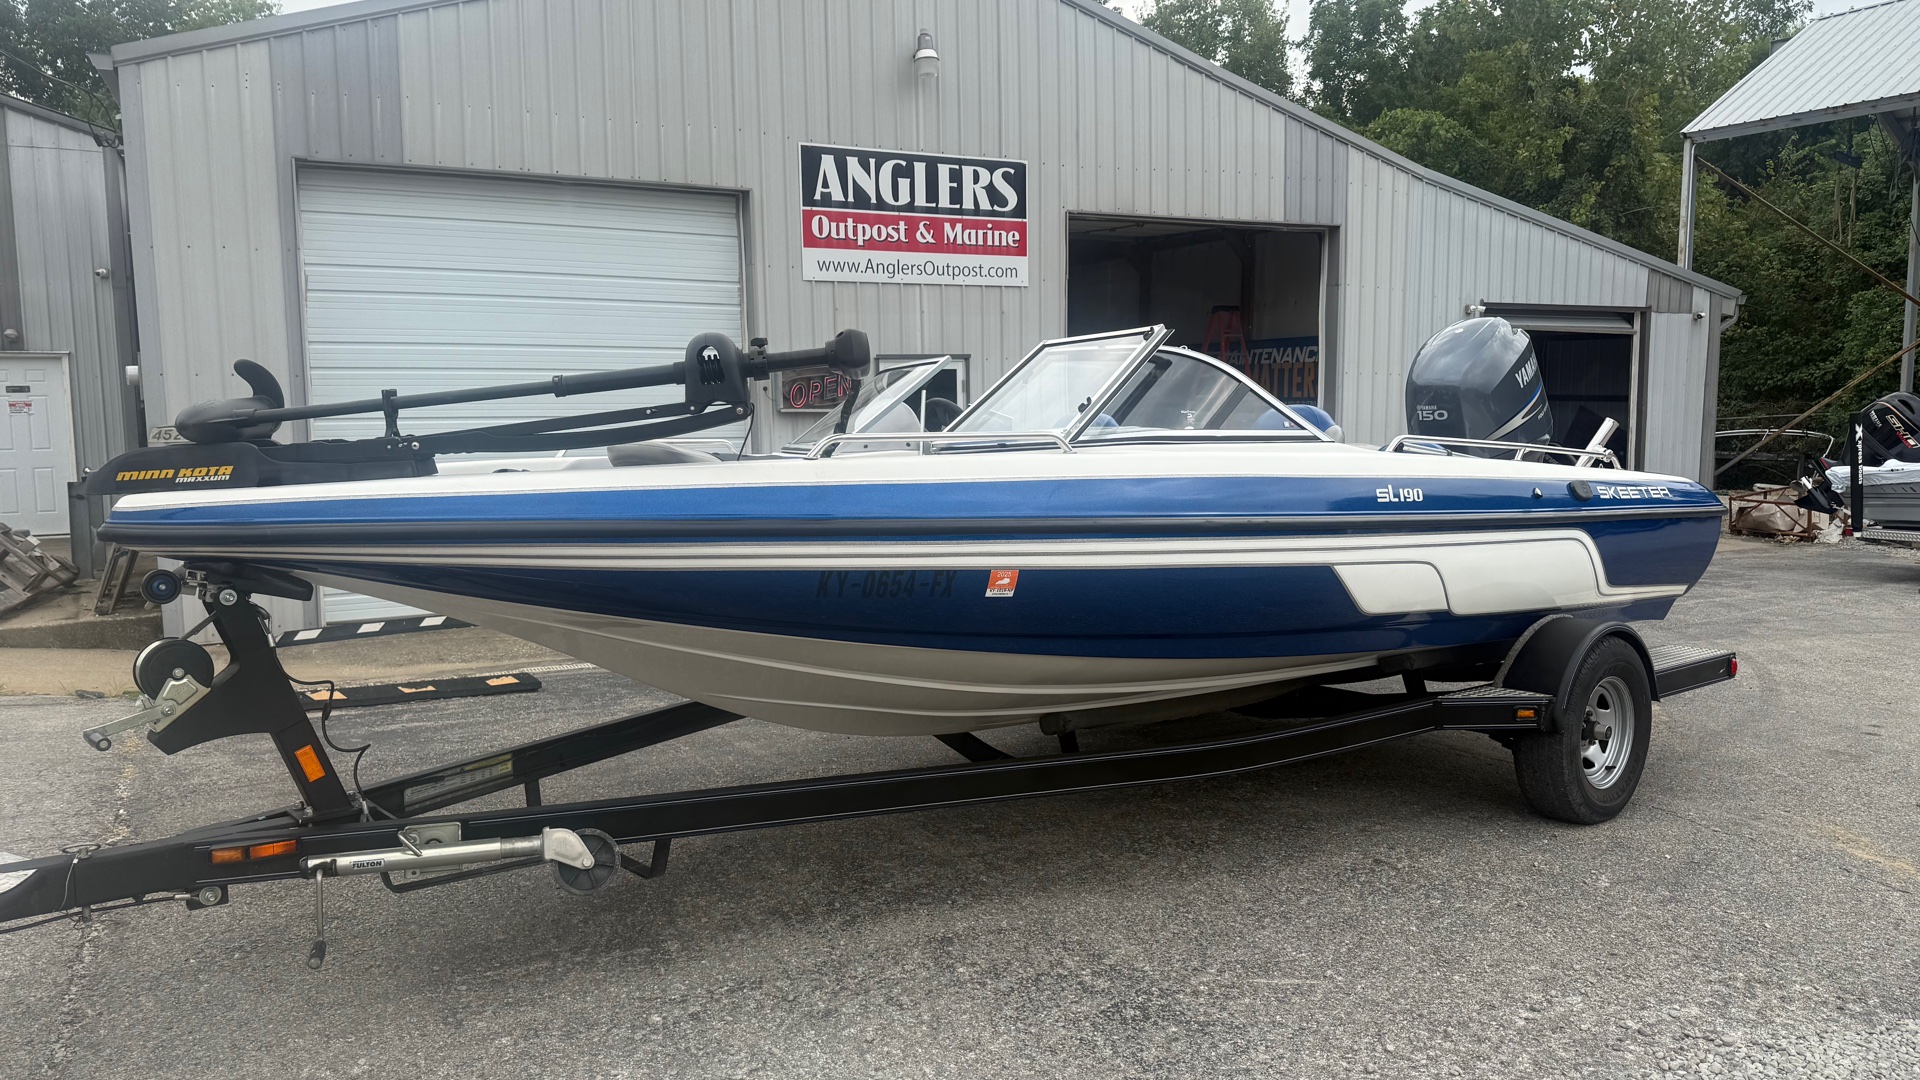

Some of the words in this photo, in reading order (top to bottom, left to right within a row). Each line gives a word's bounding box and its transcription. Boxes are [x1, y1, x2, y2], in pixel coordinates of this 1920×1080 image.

[813, 153, 1018, 212] ANGLERS
[811, 214, 908, 247] Outpost
[916, 221, 936, 244] &
[944, 222, 1020, 248] Marine
[816, 257, 1018, 279] www.AnglersOutpost.com
[1226, 346, 1319, 366] AINTENANC
[1250, 362, 1317, 398] ATTER
[790, 374, 852, 408] OPEN
[1416, 410, 1449, 421] 150
[115, 469, 175, 482] MINN
[177, 465, 235, 478] KOTA
[175, 474, 231, 484] MAXXUM
[1375, 484, 1424, 503] SL190
[1596, 485, 1674, 499] SKEETER
[815, 570, 958, 598] KY-0654-FX
[353, 860, 382, 869] FULTON
